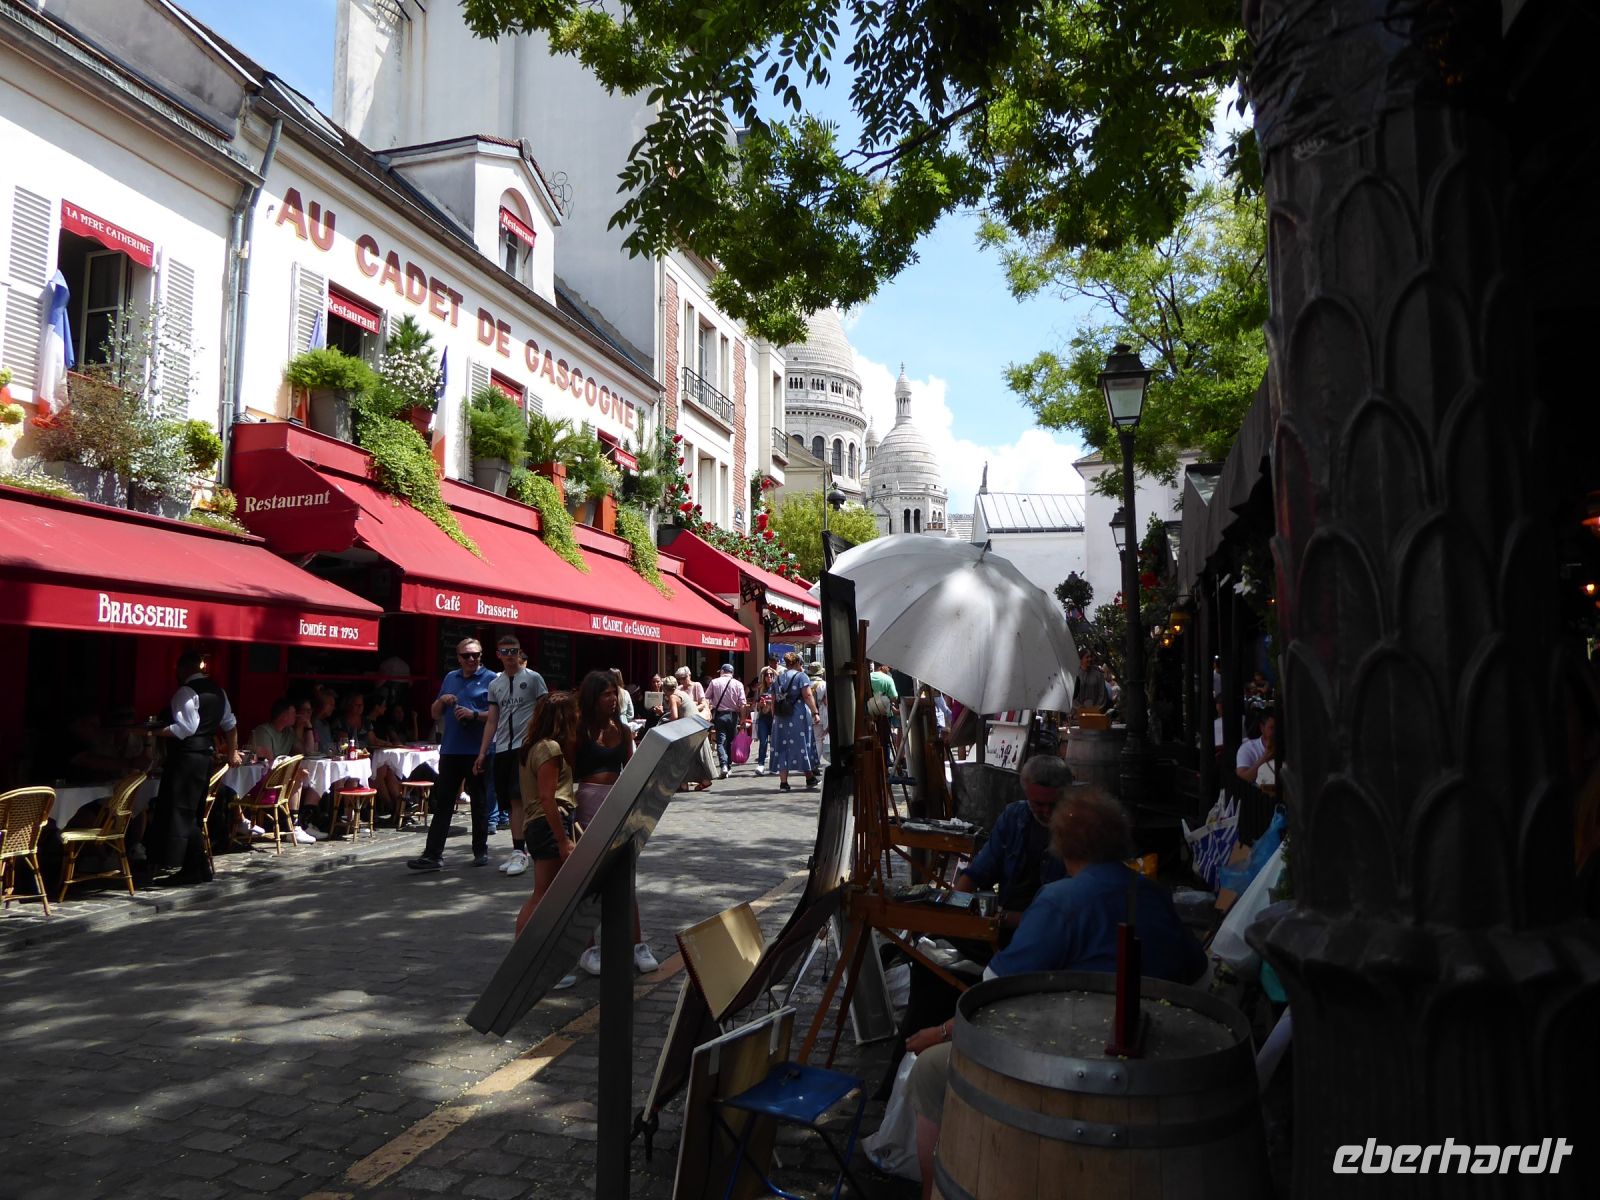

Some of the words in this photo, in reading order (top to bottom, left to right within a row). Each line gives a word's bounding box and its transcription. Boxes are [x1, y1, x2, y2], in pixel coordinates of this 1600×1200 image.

[65, 206, 78, 220] LA
[80, 213, 105, 233] MERE
[105, 226, 152, 255] CATHERINE
[275, 187, 337, 252] AU
[354, 233, 463, 328] CADET
[476, 306, 512, 358] DE
[524, 339, 635, 430] GASCOGNE
[328, 296, 376, 330] Restaurant
[244, 490, 330, 513] Restaurant
[98, 593, 188, 629] BRASSERIE
[435, 593, 461, 612] Café
[477, 600, 519, 620] Brasserie
[329, 625, 338, 638] EN
[340, 627, 359, 640] 1793
[592, 616, 602, 629] AU
[602, 616, 623, 633] CADET
[624, 623, 632, 634] de
[632, 621, 661, 639] GASCOGNE
[701, 633, 722, 646] Restaurant
